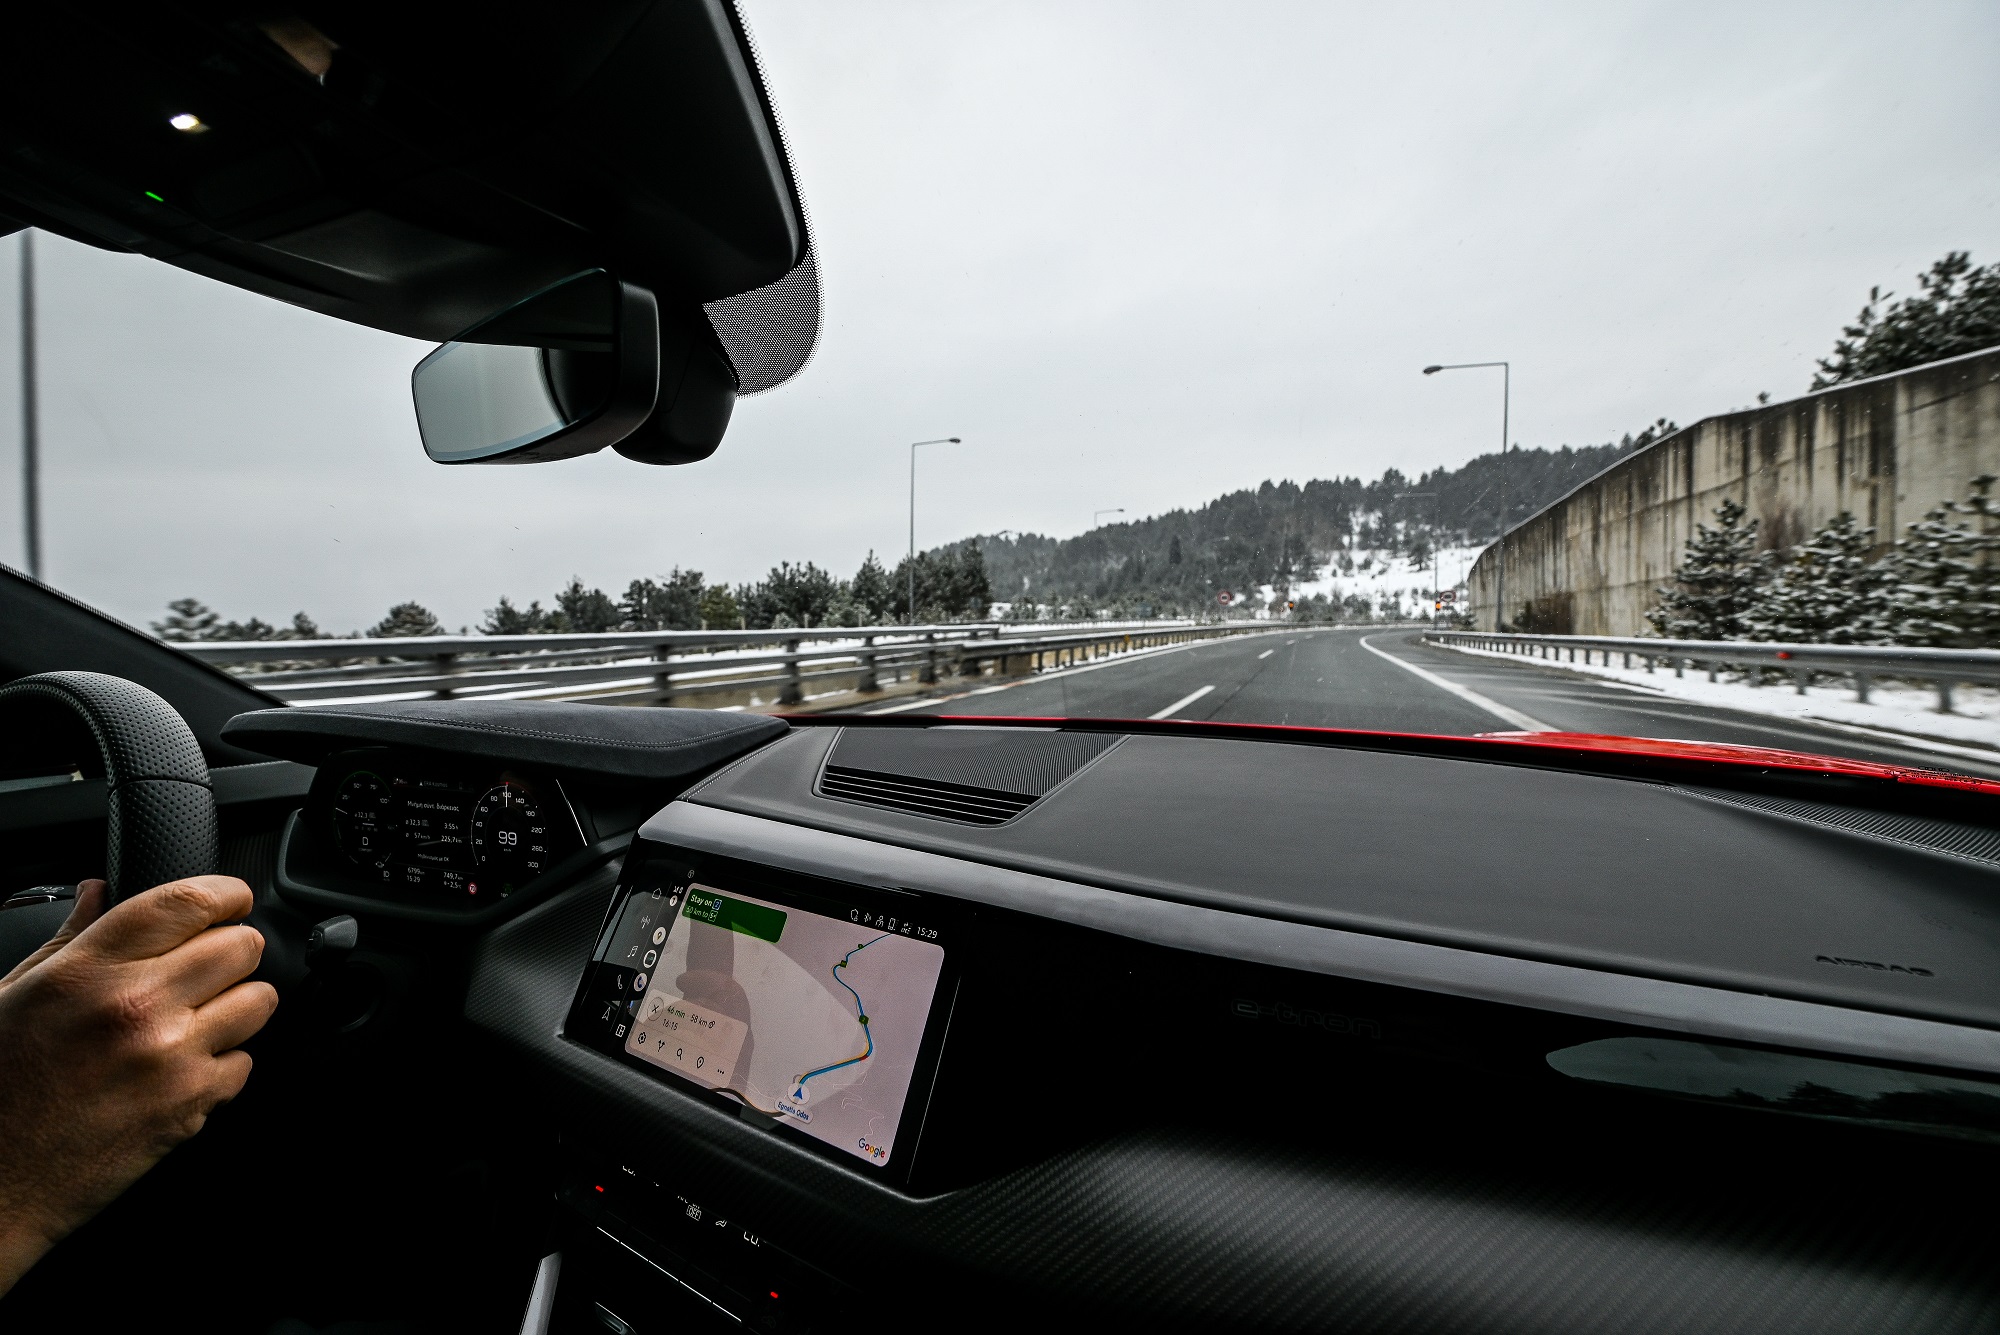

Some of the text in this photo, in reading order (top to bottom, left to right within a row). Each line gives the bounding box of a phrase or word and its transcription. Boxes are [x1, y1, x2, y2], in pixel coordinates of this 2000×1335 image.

[498, 830, 518, 846] 99
[690, 894, 704, 906] Stay
[917, 926, 937, 939] 15:29
[1815, 954, 1935, 978] AIRBAG
[662, 1018, 678, 1030] 16:15
[667, 1005, 708, 1028] 46 min 58 km
[1230, 997, 1382, 1039] e-tron
[796, 1110, 809, 1120] Odos
[858, 1137, 885, 1158] Google
